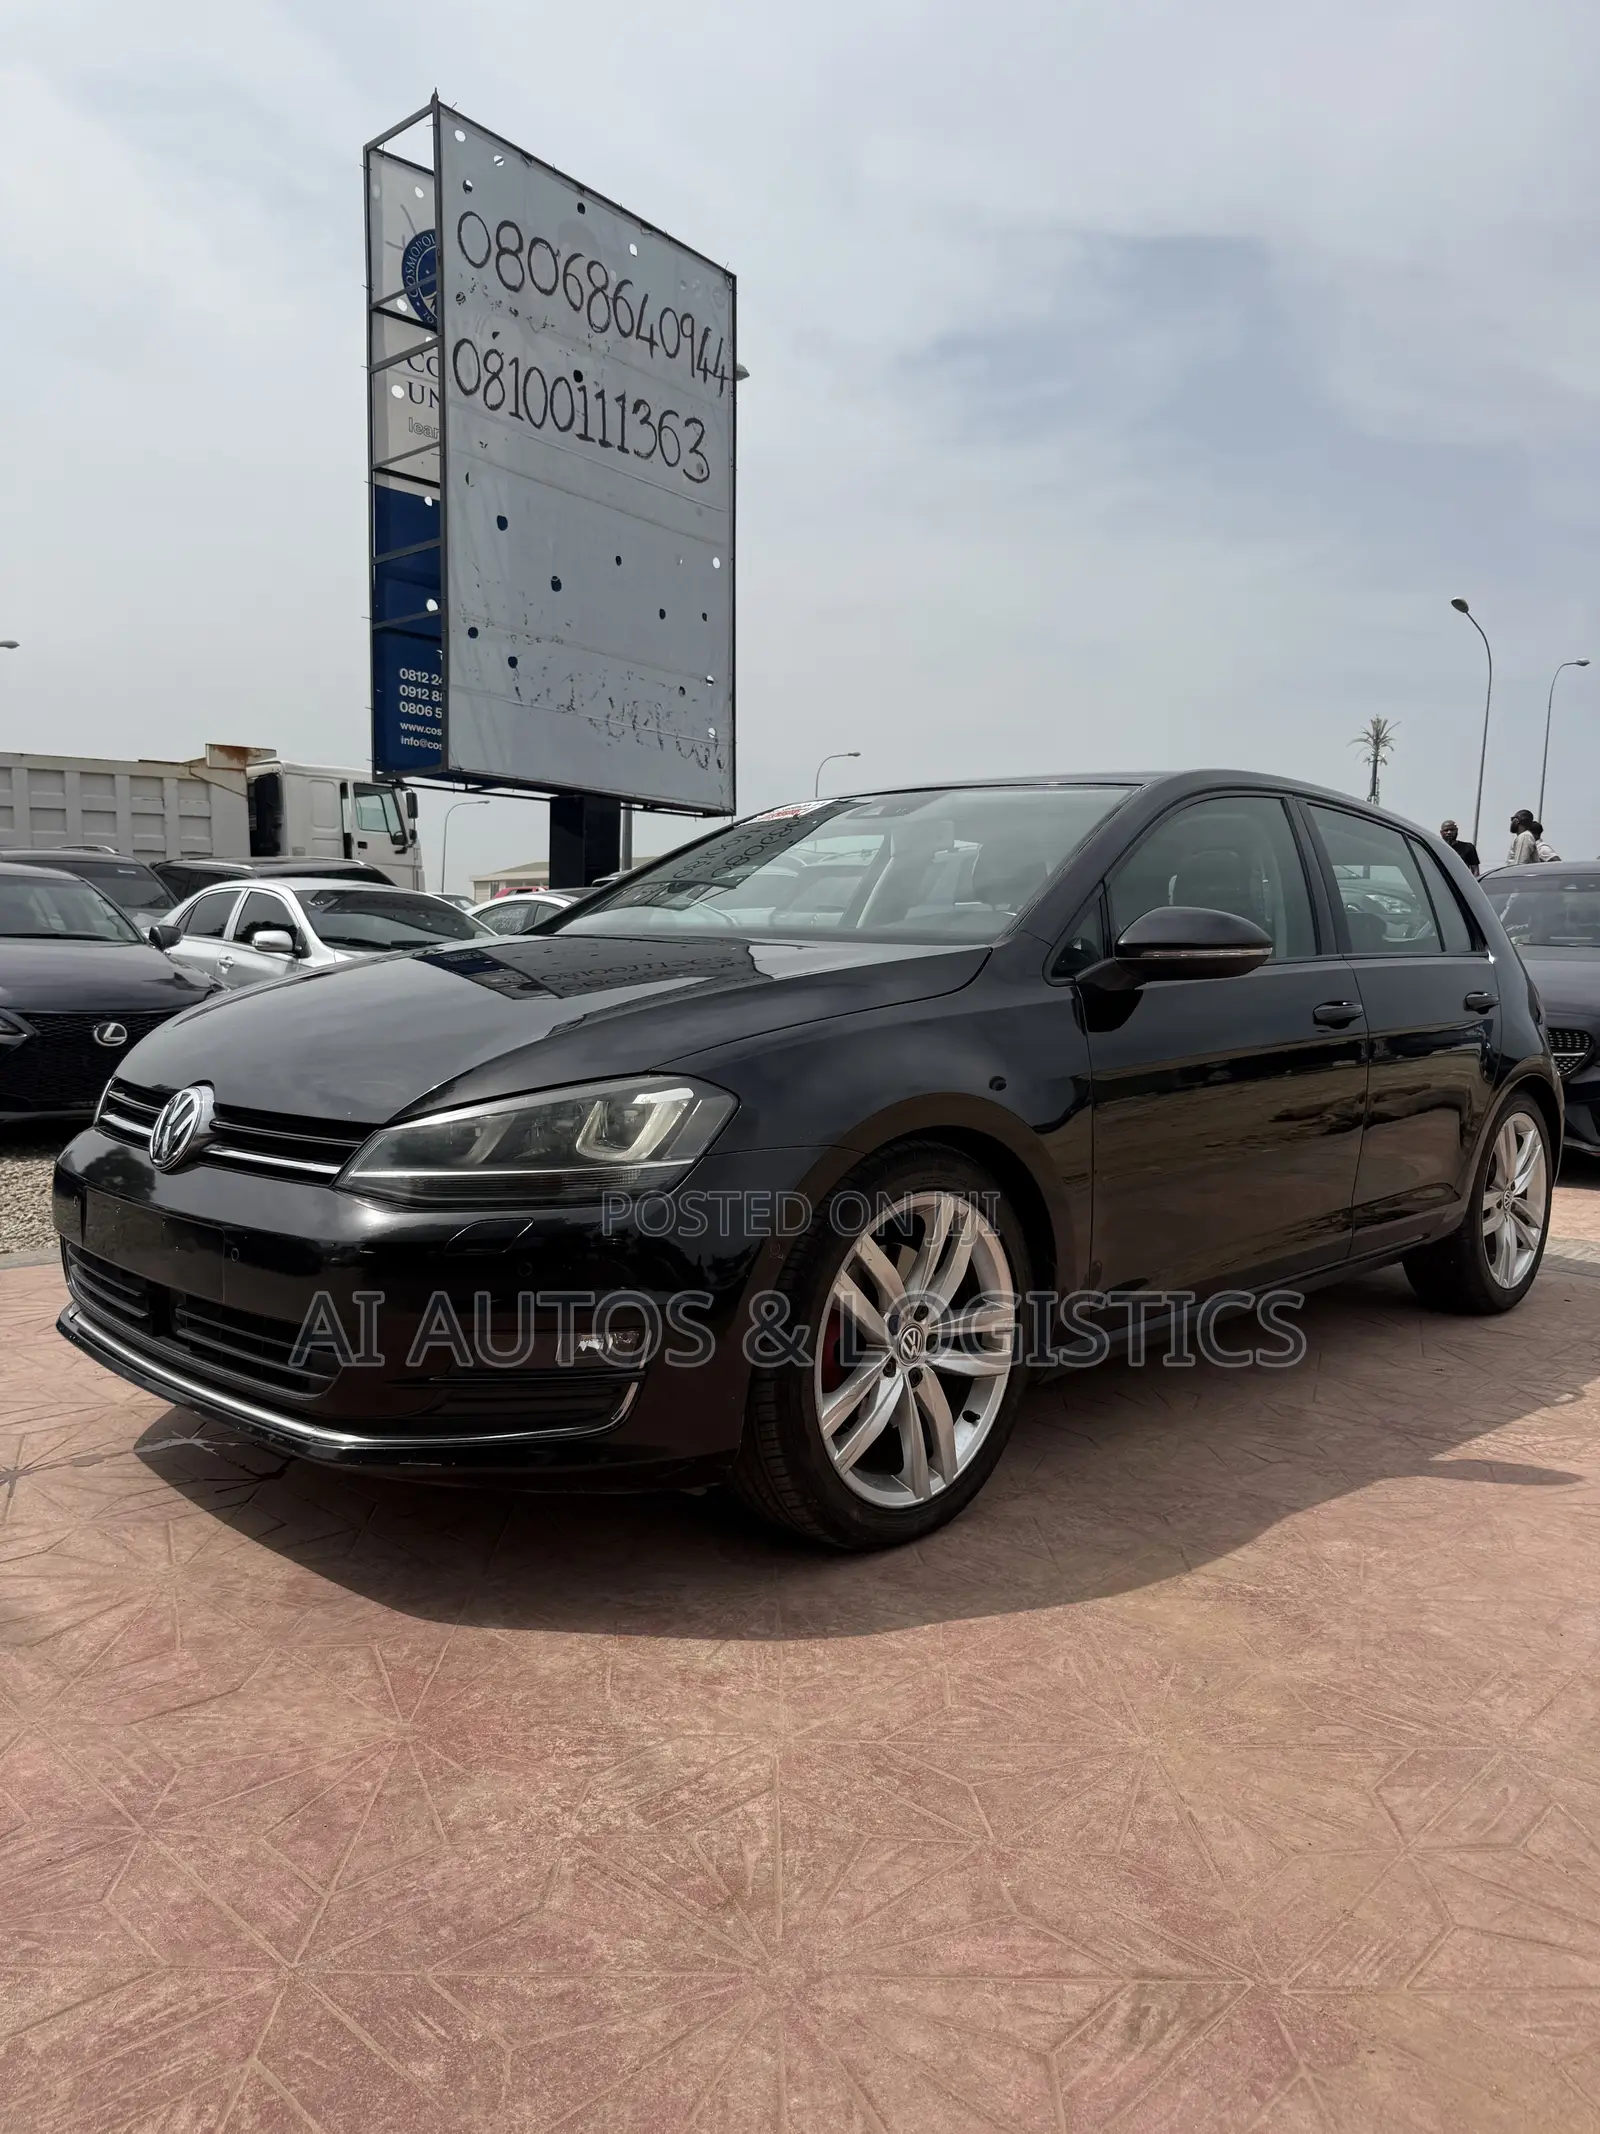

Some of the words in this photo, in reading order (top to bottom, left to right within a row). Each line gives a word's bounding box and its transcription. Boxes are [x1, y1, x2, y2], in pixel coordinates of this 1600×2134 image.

[457, 210, 734, 397] 08068640944
[453, 338, 710, 483] 08100111363
[399, 667, 429, 683] 0812
[399, 684, 429, 700] 0912
[399, 701, 433, 717] 0806
[399, 722, 442, 735] www.cos
